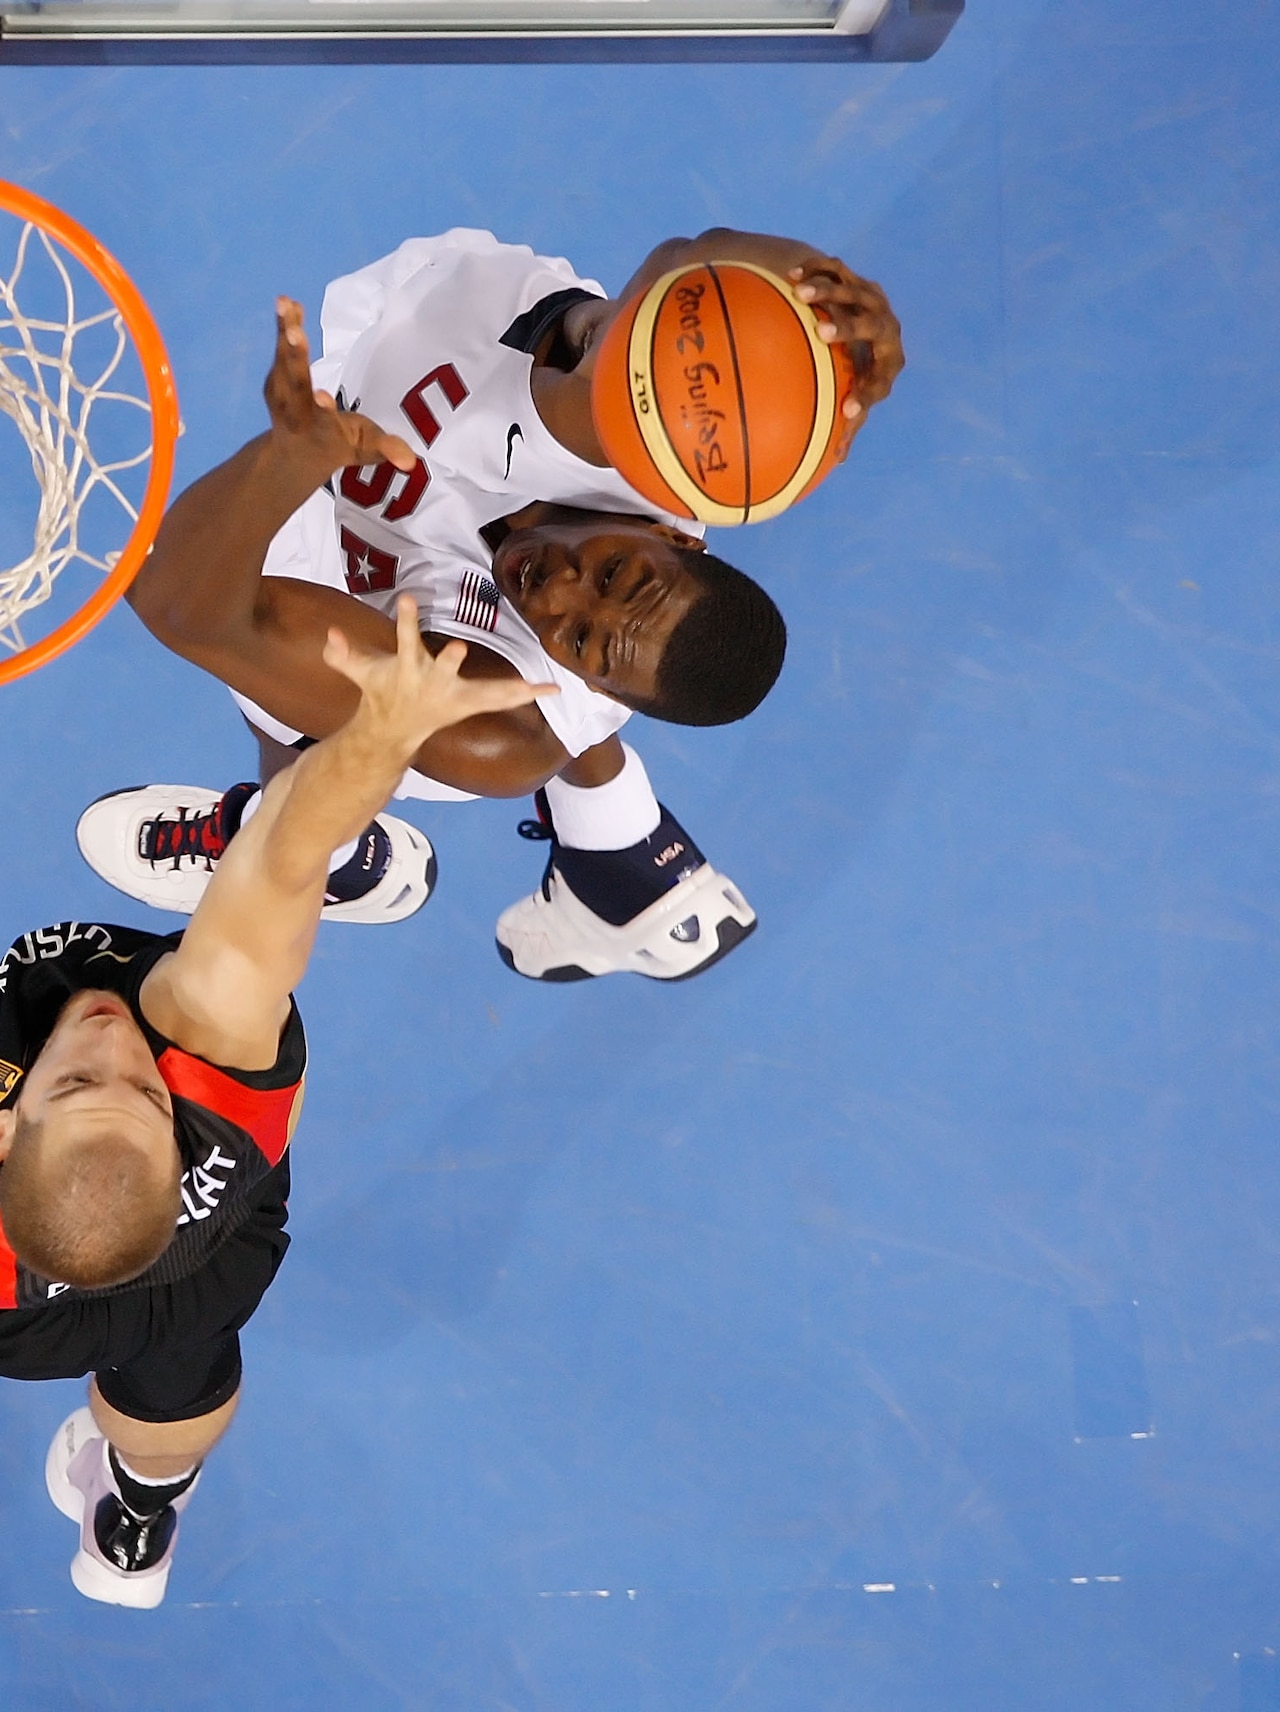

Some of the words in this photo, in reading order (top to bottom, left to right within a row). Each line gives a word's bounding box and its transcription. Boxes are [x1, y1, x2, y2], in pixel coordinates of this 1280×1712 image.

[676, 283, 706, 355] 2008
[679, 361, 727, 484] Beijing
[339, 361, 470, 595] USA
[653, 841, 685, 867] USA
